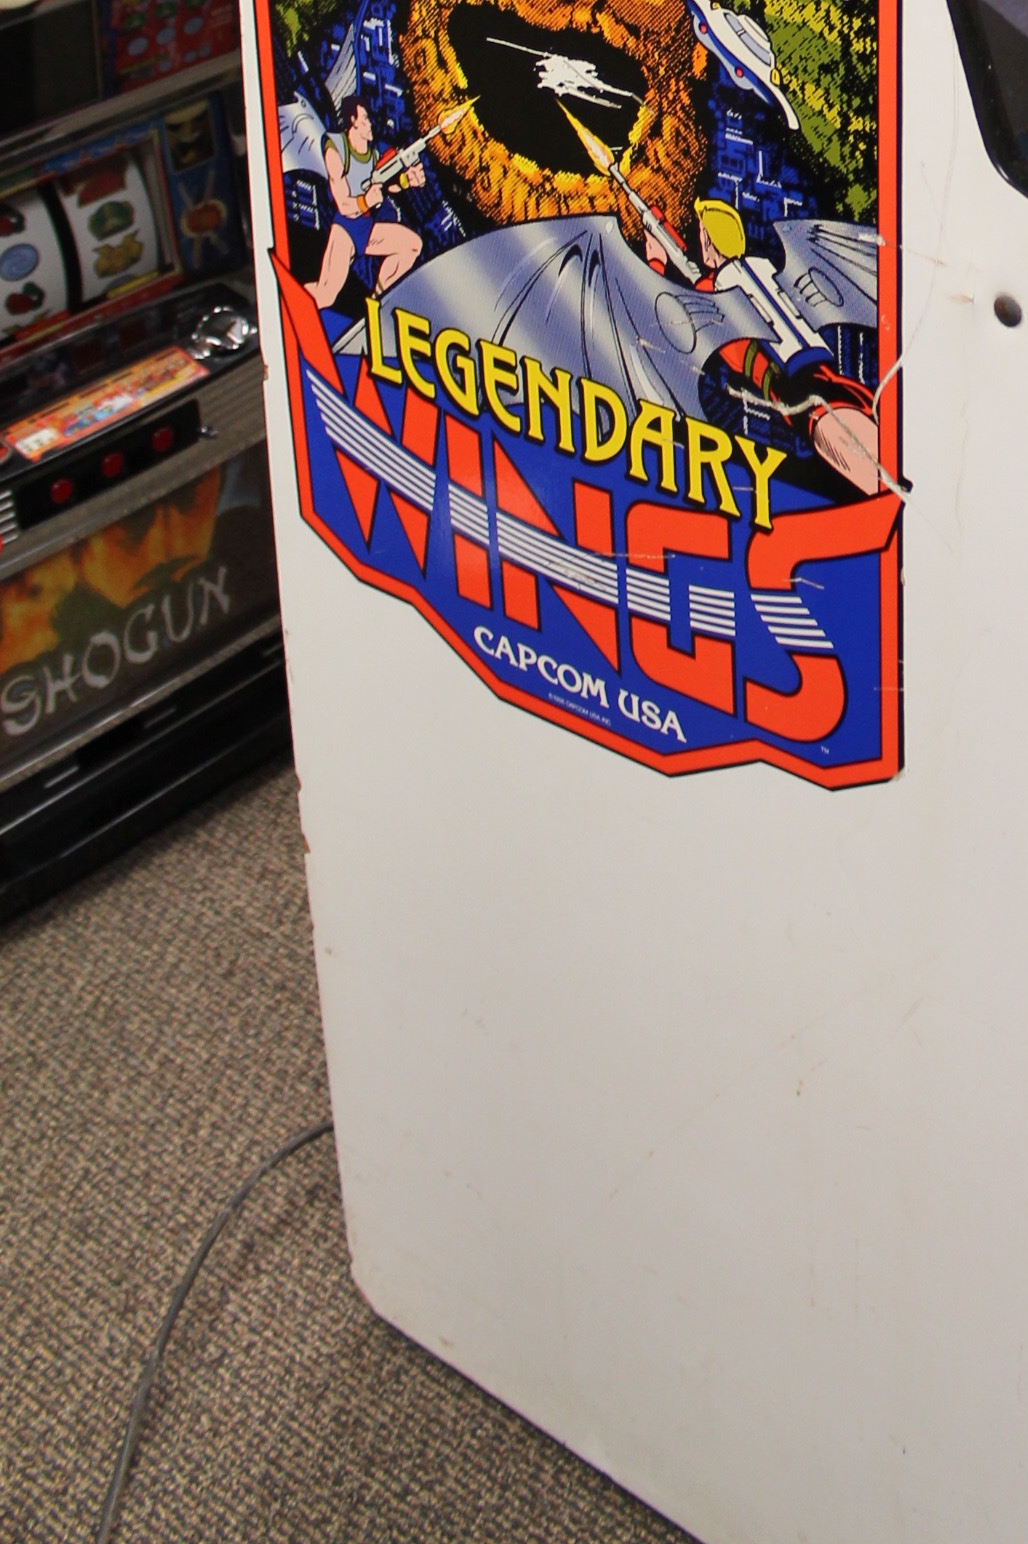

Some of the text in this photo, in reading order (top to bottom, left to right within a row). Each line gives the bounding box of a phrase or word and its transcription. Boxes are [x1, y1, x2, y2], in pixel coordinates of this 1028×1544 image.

[272, 252, 906, 743] WINGS
[365, 298, 788, 531] LEGENDARY
[0, 565, 231, 737] SHOGUN
[473, 624, 688, 744] CAPCOM USA
